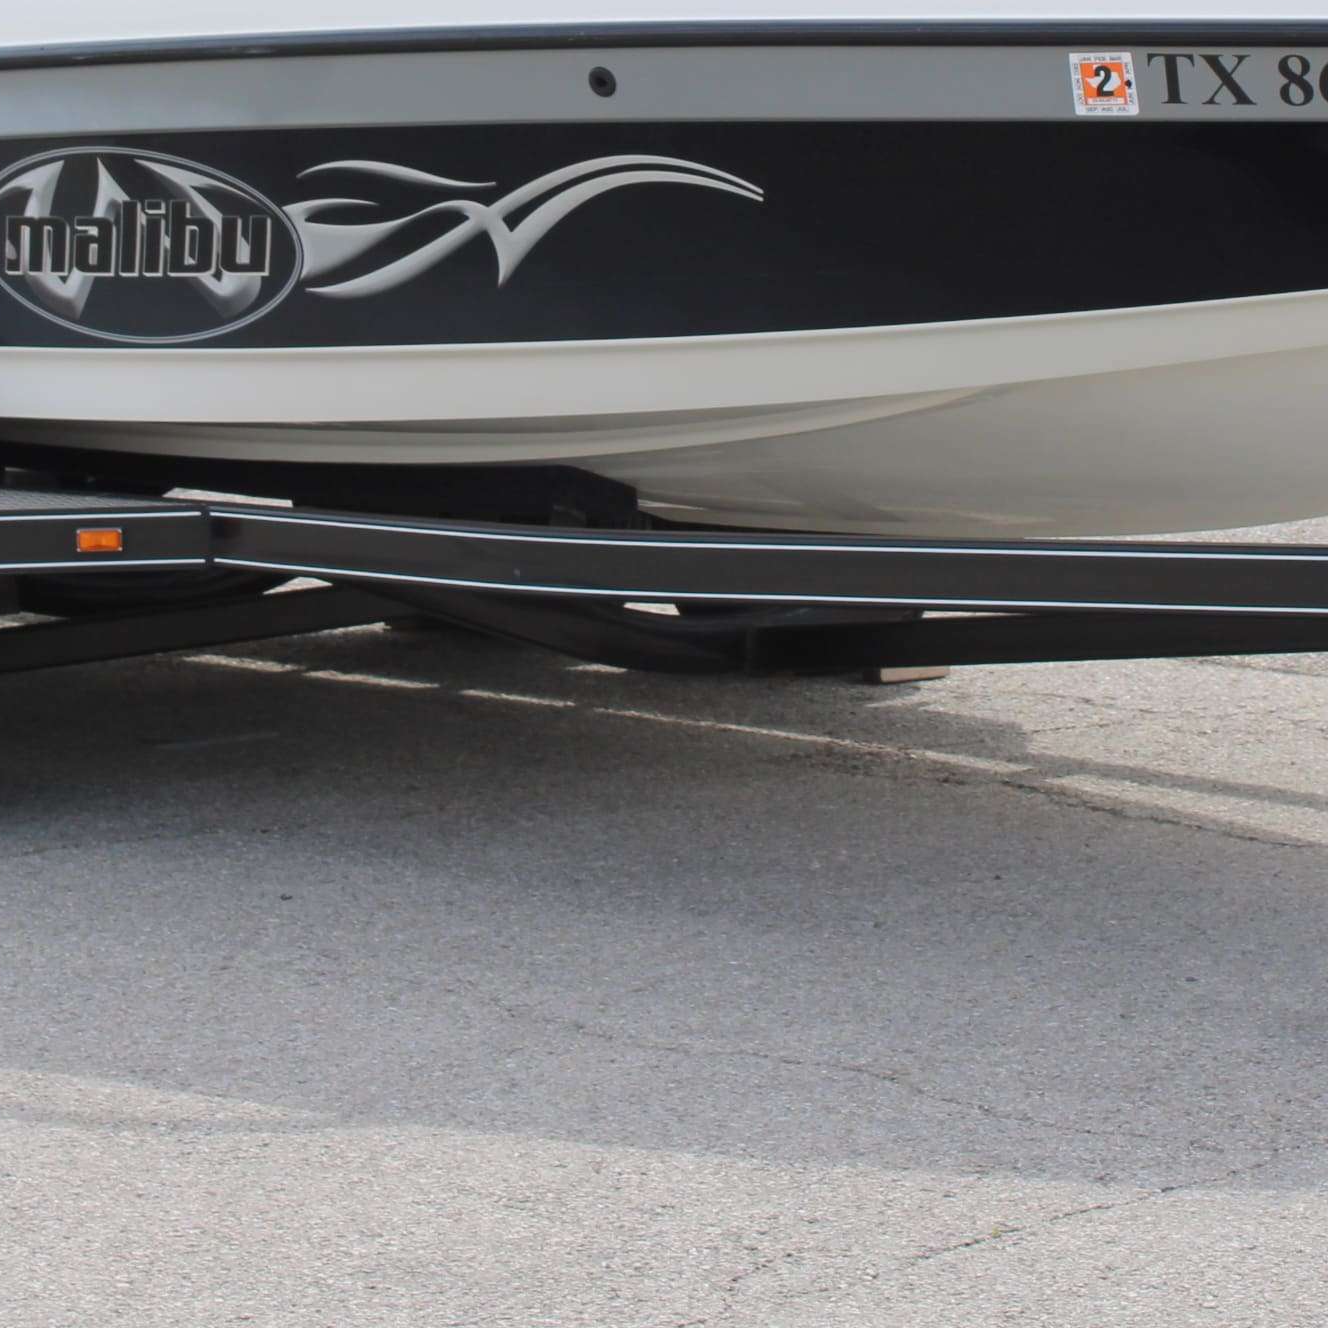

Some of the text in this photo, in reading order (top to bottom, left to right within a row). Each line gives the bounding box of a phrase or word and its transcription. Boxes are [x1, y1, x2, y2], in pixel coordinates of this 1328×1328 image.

[1094, 65, 1114, 97] 2
[1146, 52, 1256, 106] TX
[5, 199, 272, 277] malibu
